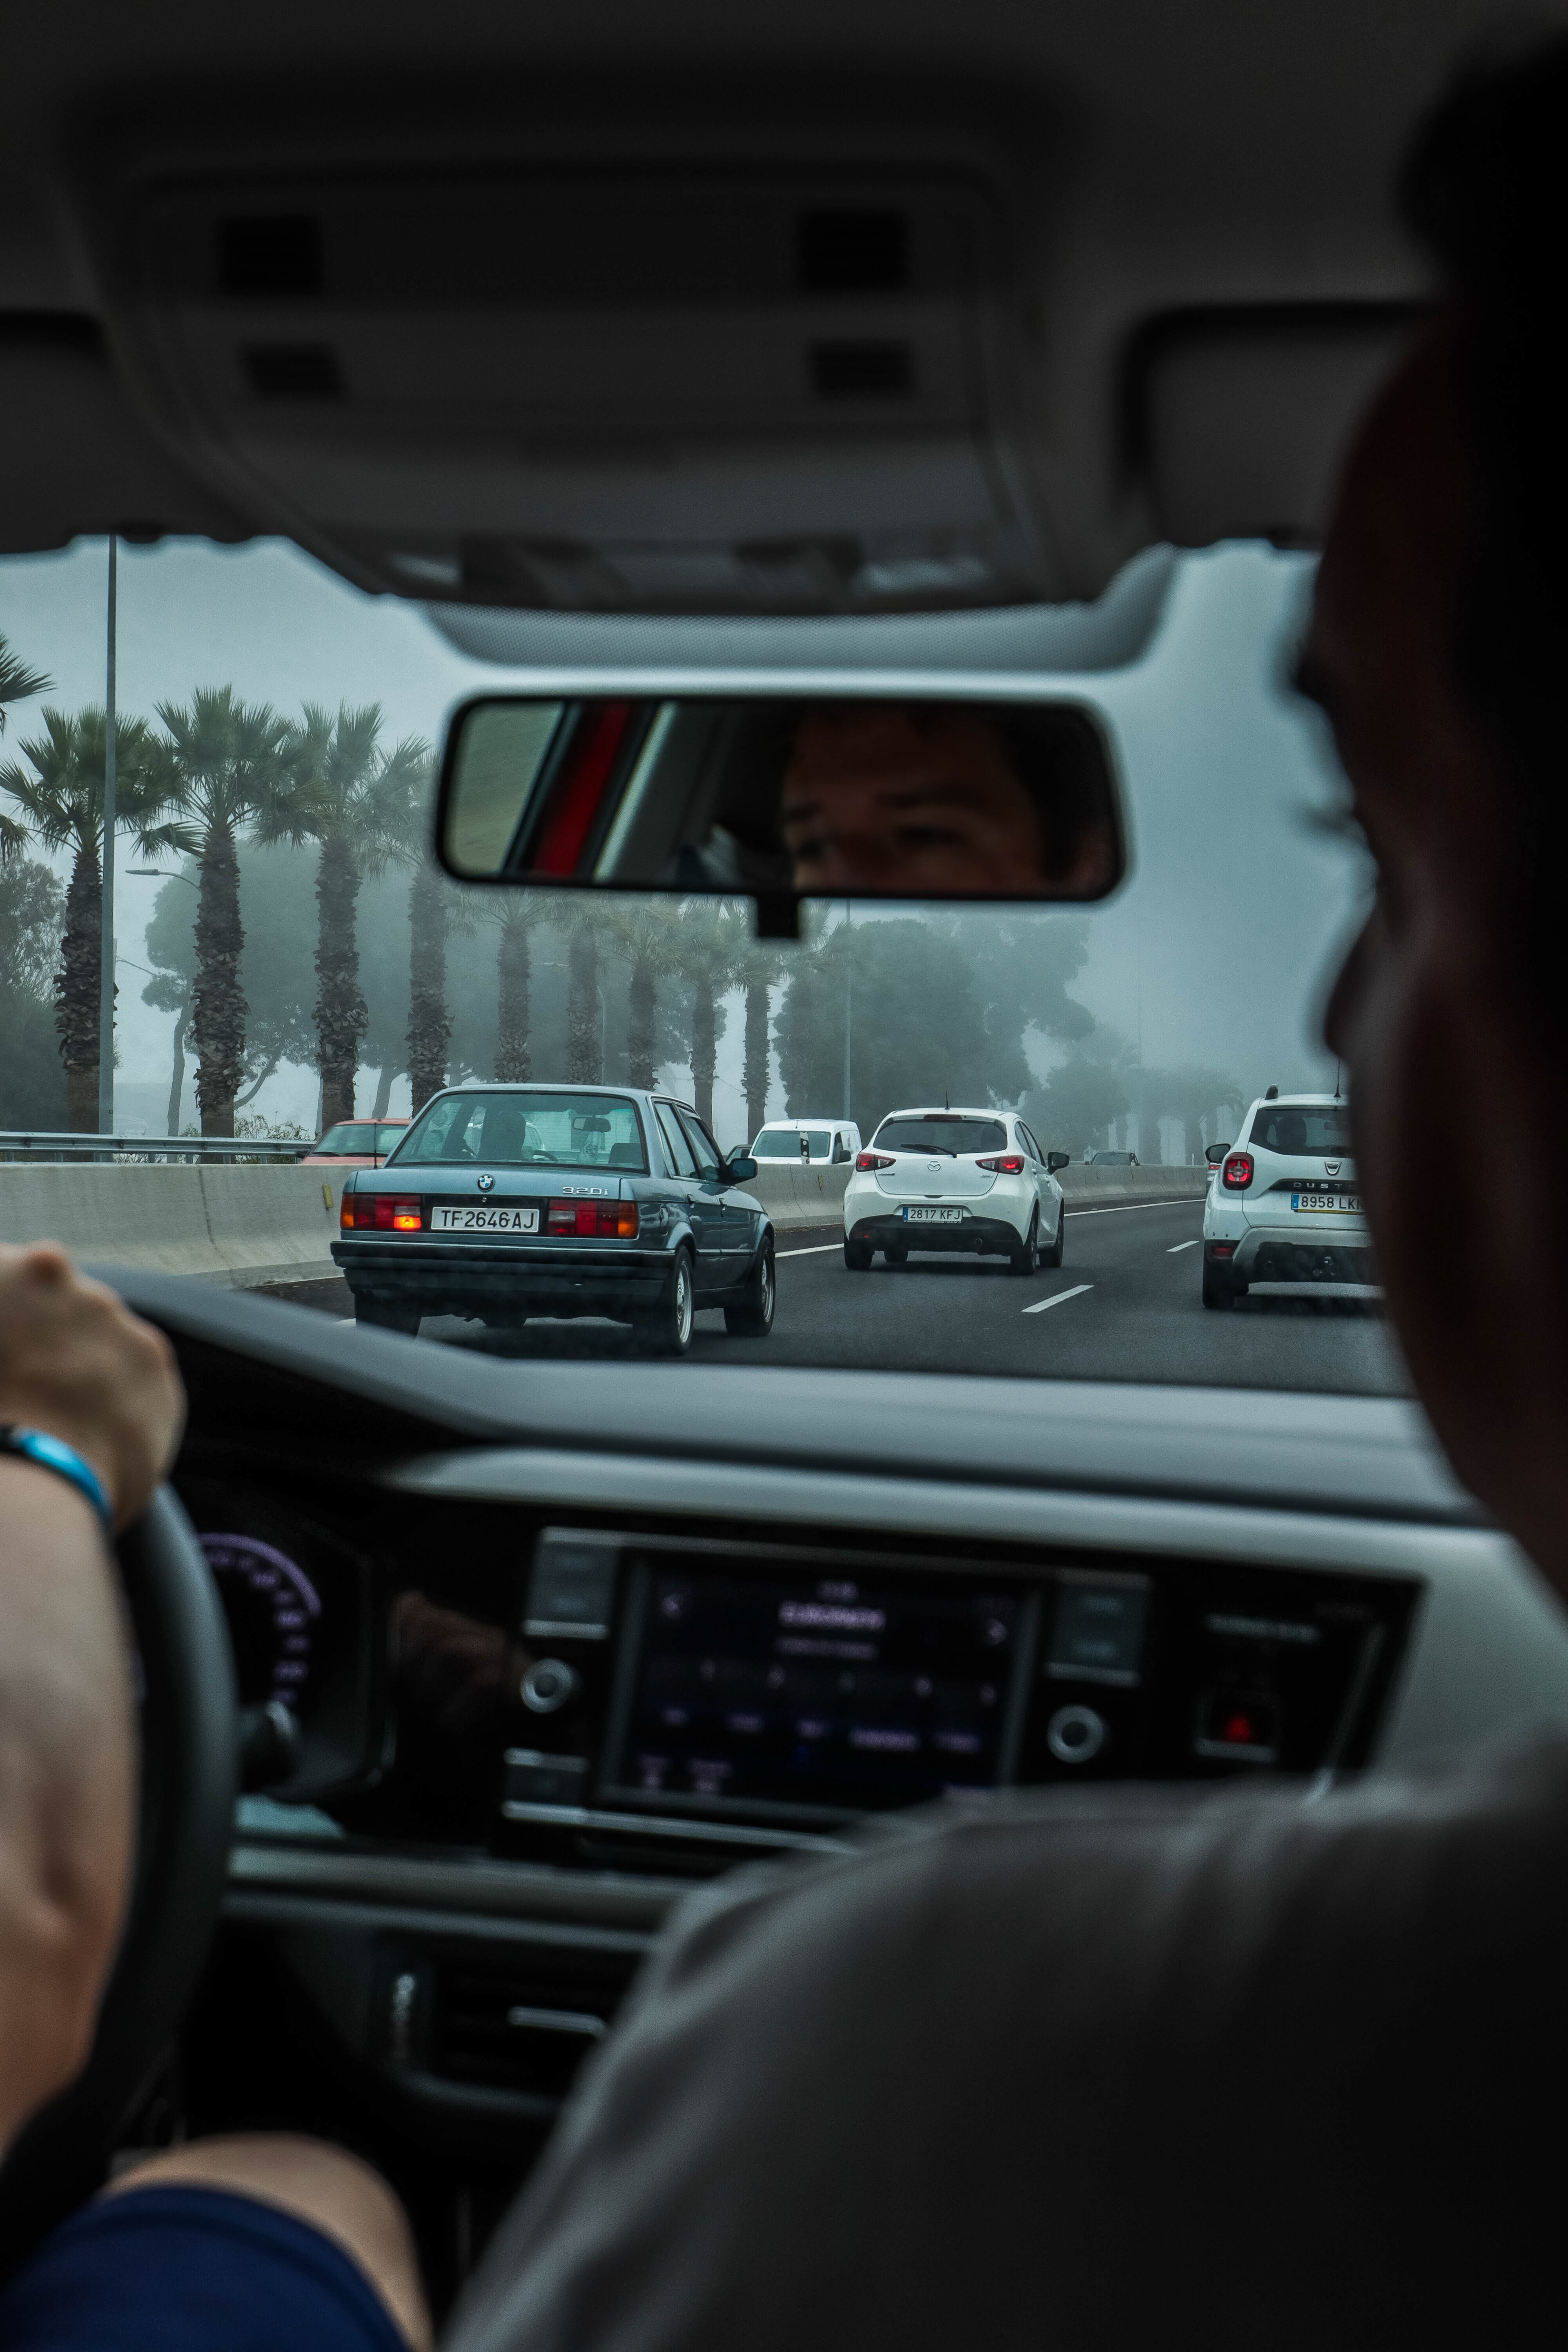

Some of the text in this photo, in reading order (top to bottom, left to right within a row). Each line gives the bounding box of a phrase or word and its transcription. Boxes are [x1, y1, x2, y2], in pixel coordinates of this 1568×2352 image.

[563, 1187, 608, 1195] 320i
[1301, 1196, 1334, 1208] 8958
[910, 1209, 960, 1219] 2817 KFJ
